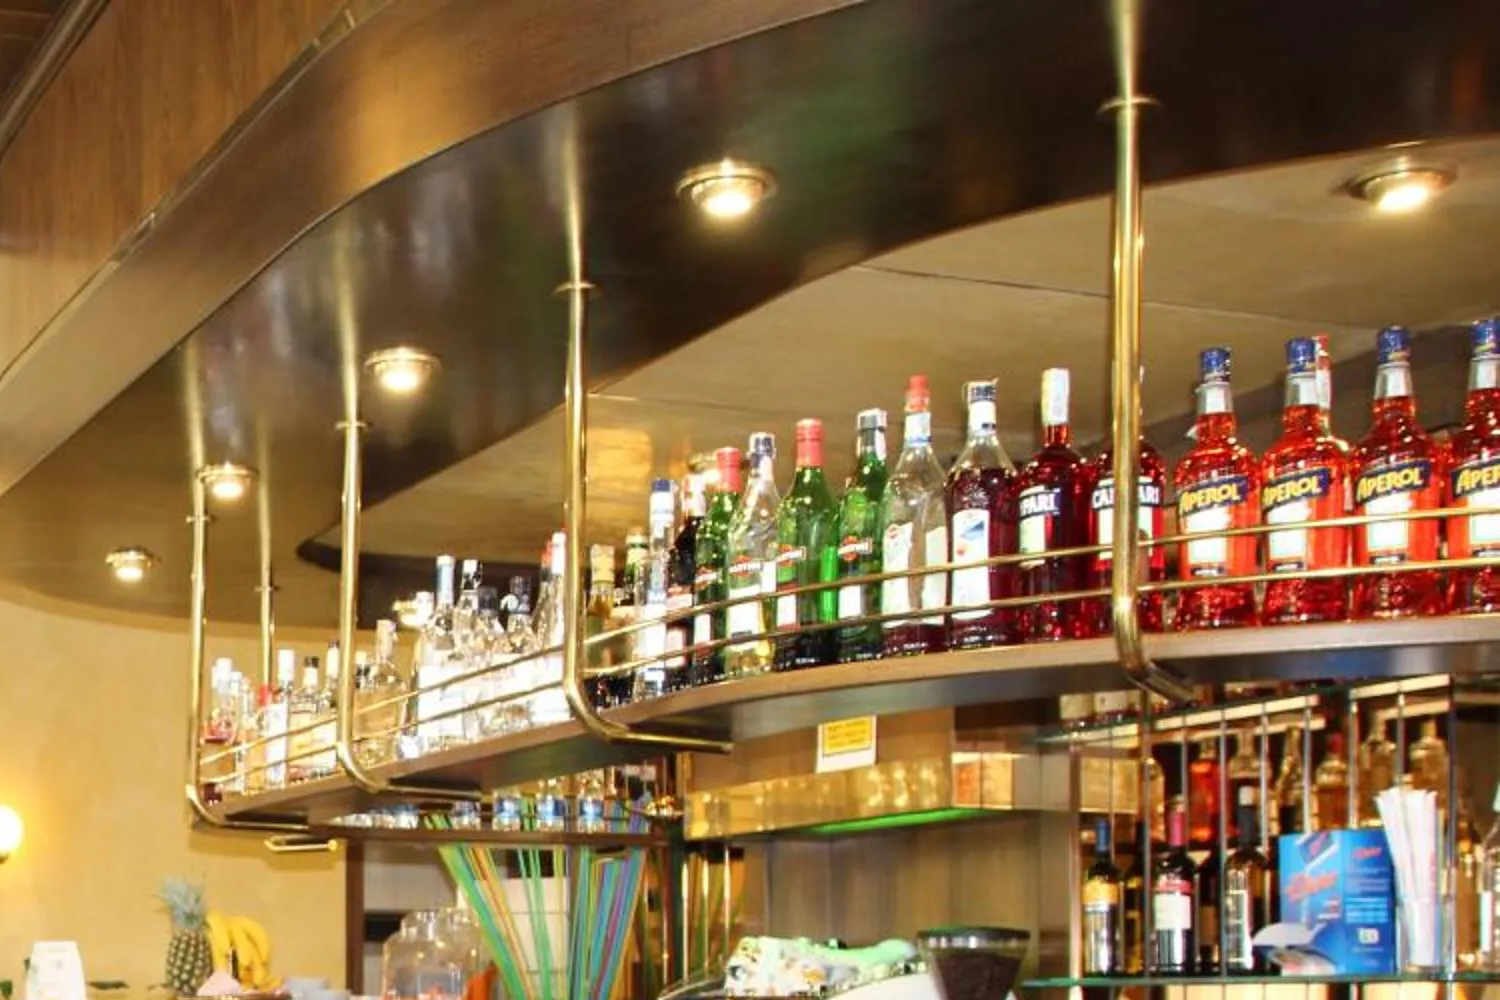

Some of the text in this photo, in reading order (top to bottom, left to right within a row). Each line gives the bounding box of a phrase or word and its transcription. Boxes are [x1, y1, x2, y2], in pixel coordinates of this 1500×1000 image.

[1263, 475, 1323, 507] APEROL
[1357, 467, 1423, 500] APEROL
[1456, 464, 1500, 494] APER
[1092, 485, 1160, 510] CAARI
[1180, 483, 1241, 514] APEROL
